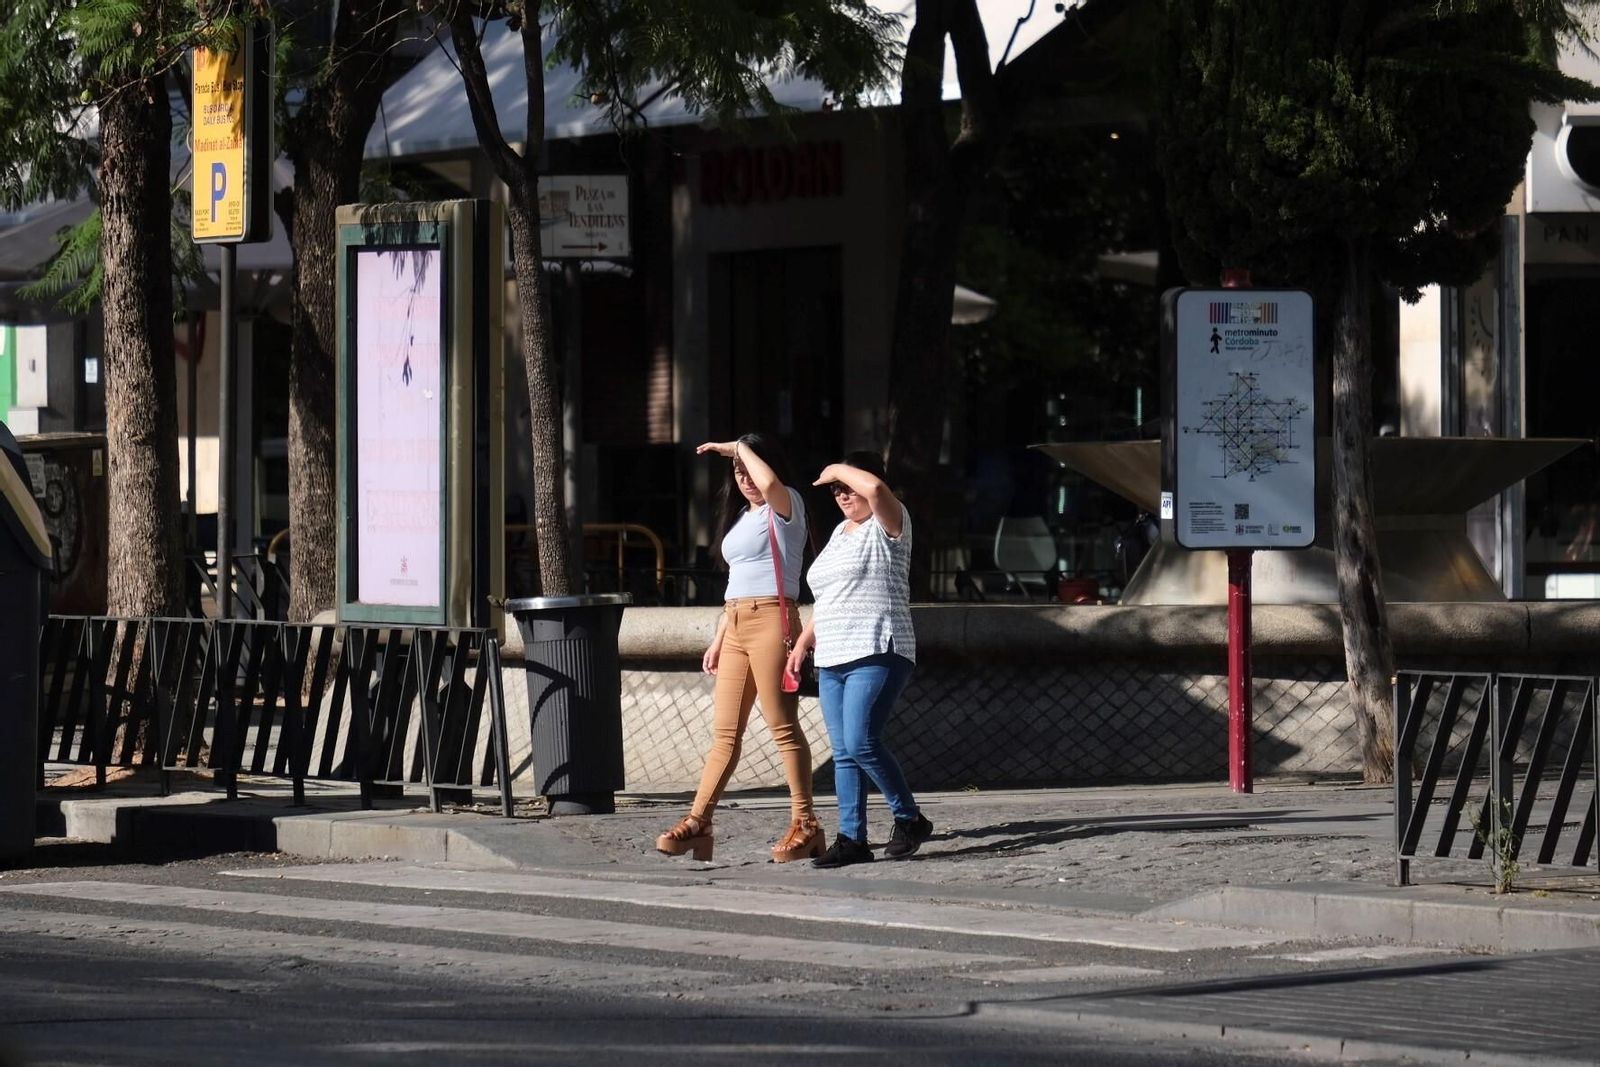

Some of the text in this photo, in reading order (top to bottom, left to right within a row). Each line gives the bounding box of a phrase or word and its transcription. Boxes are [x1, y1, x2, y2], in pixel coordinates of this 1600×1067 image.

[211, 163, 227, 223] P
[569, 211, 625, 229] TENDILLAS
[1544, 225, 1588, 243] PAN
[1225, 328, 1278, 337] metrominuto
[1225, 337, 1259, 346] Córdoba
